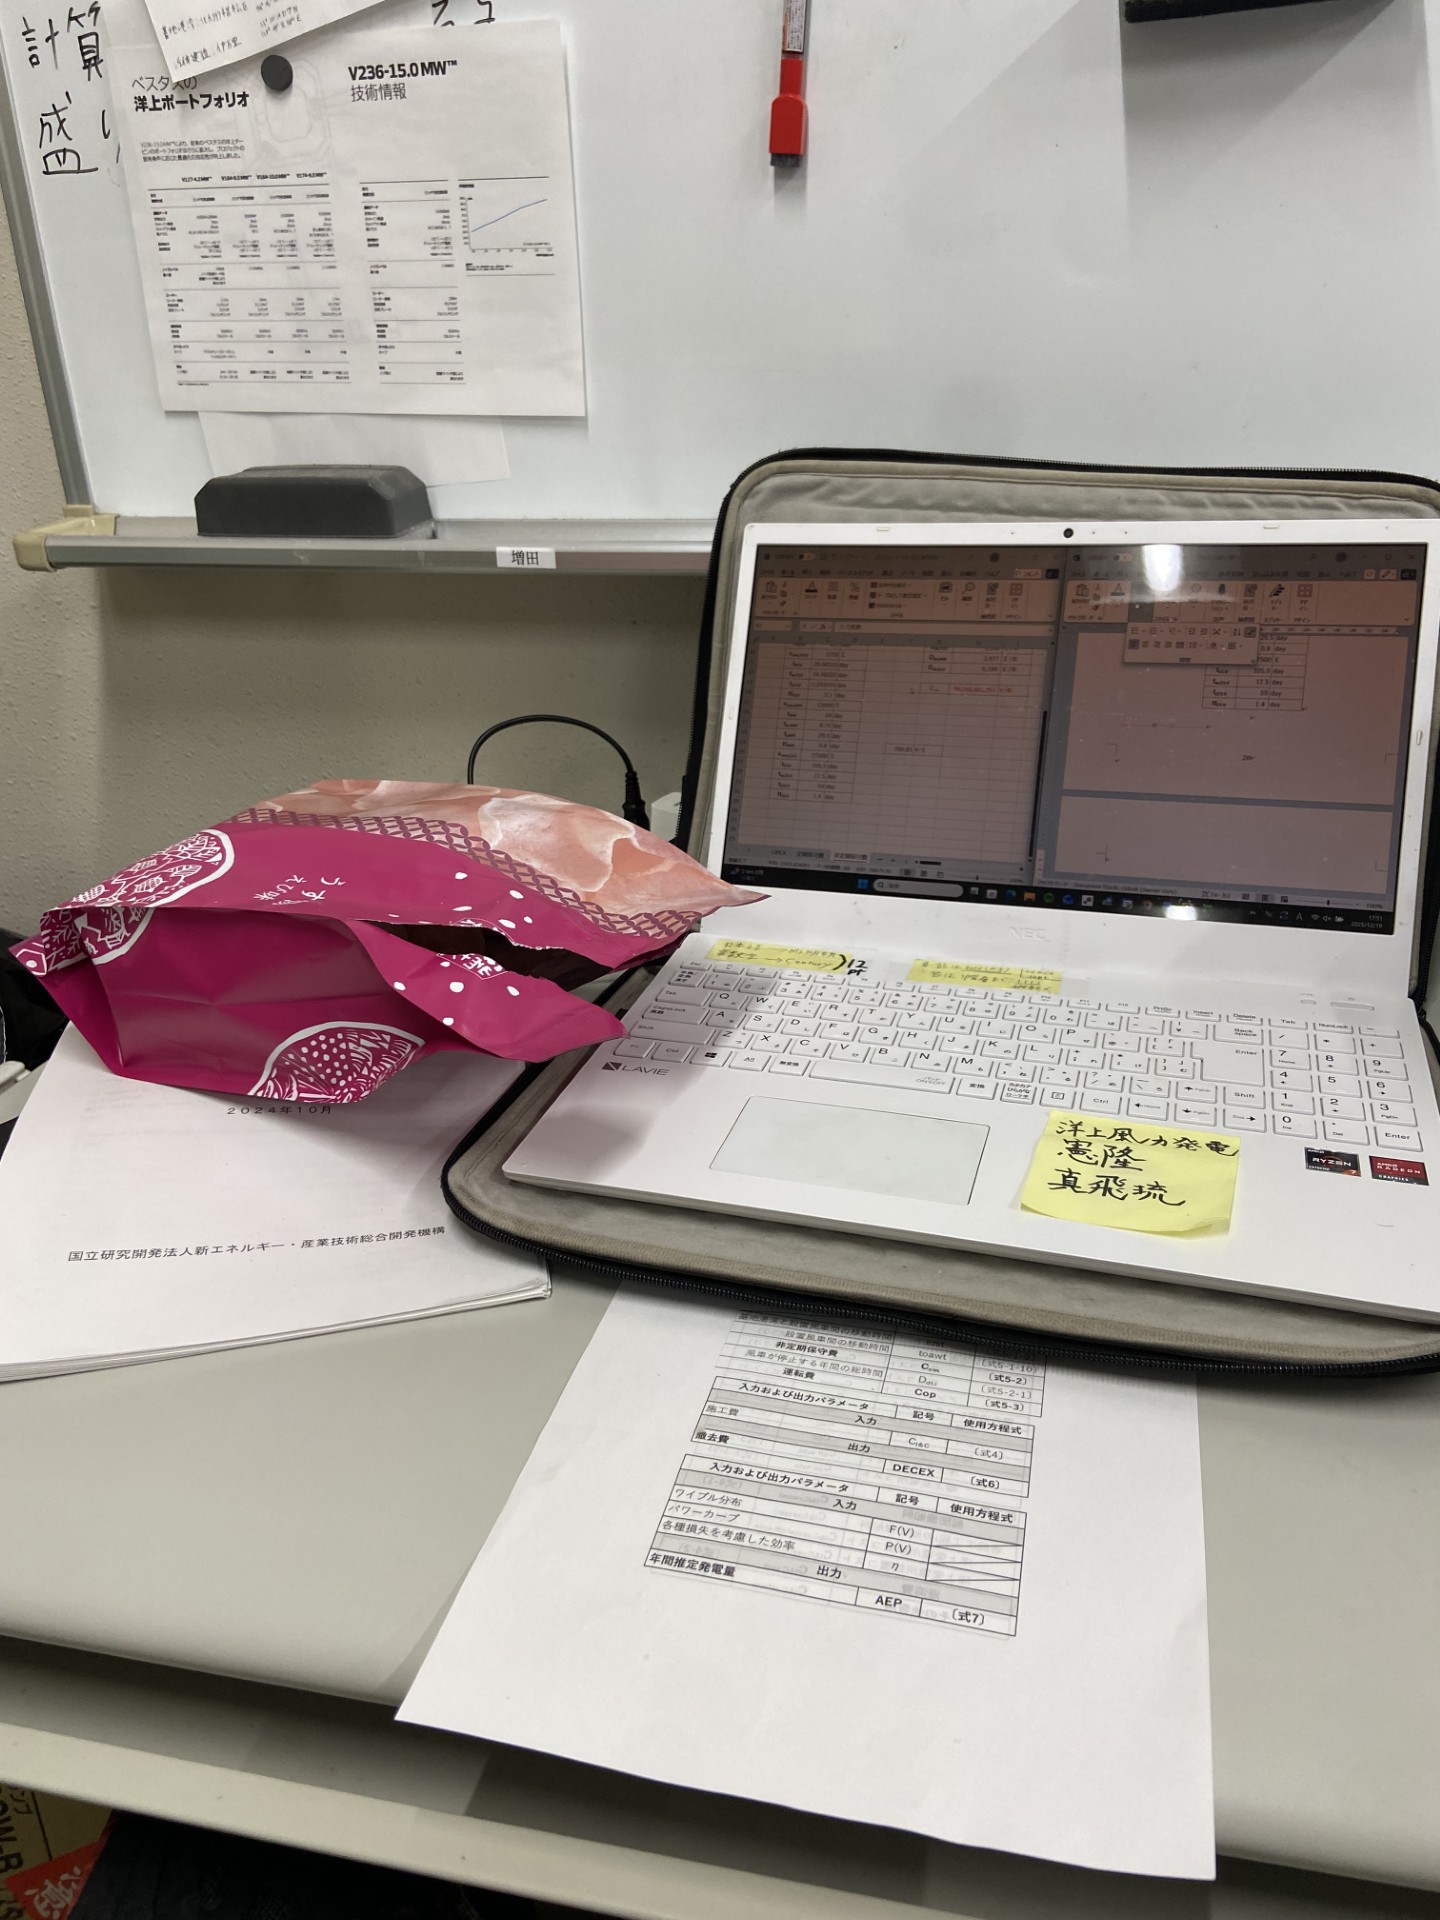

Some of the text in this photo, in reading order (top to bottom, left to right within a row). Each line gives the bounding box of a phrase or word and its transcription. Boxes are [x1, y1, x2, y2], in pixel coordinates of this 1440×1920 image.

[351, 83, 407, 102] 技術情報
[133, 91, 250, 112] 洋上ポートフォリオ
[511, 550, 539, 565] 増田
[1009, 926, 1048, 940] NEC
[960, 1057, 974, 1065] M
[622, 1064, 670, 1076] LAVIE
[226, 1106, 333, 1115] 2024年10月
[1056, 1120, 1239, 1156] 洋上風力発電
[1057, 1138, 1147, 1171] 憲隆
[1312, 1157, 1352, 1167] RYZEN
[1377, 1165, 1421, 1174] RADEON
[1047, 1168, 1186, 1206] 真飛琉
[67, 1225, 446, 1263] 国立研究開発法人新エネルギー・産業技術総合開発機構
[785, 1330, 890, 1353] 設置風車間の移動時間
[775, 1341, 839, 1358] 非定期保守費
[744, 1348, 884, 1378] 風車が停止する年間の総時間
[782, 1367, 816, 1380] 運転費
[739, 1381, 870, 1411] 入力および出力パラメータ
[914, 1388, 937, 1399] Cop
[706, 1403, 740, 1417] 施工費
[912, 1410, 935, 1422] 記号
[854, 1414, 877, 1426] 入力
[964, 1417, 1022, 1436] 使用方程式
[847, 1442, 871, 1454] 出力
[709, 1461, 850, 1493] 入力および出力パラメータ
[892, 1463, 935, 1478] DECEX
[674, 1488, 743, 1508] ワイブル分布
[833, 1499, 857, 1512] 入力
[895, 1494, 919, 1506] 記号
[668, 1503, 741, 1523] パワーカーブ
[949, 1502, 1014, 1524] 使用方程式
[661, 1520, 796, 1552] 各種損失を考慮した効率
[889, 1525, 915, 1538] F(V)
[885, 1541, 912, 1555] P(V)
[649, 1552, 736, 1579] 年間推定発電量
[816, 1564, 842, 1580] 出力
[875, 1595, 902, 1608] AEP
